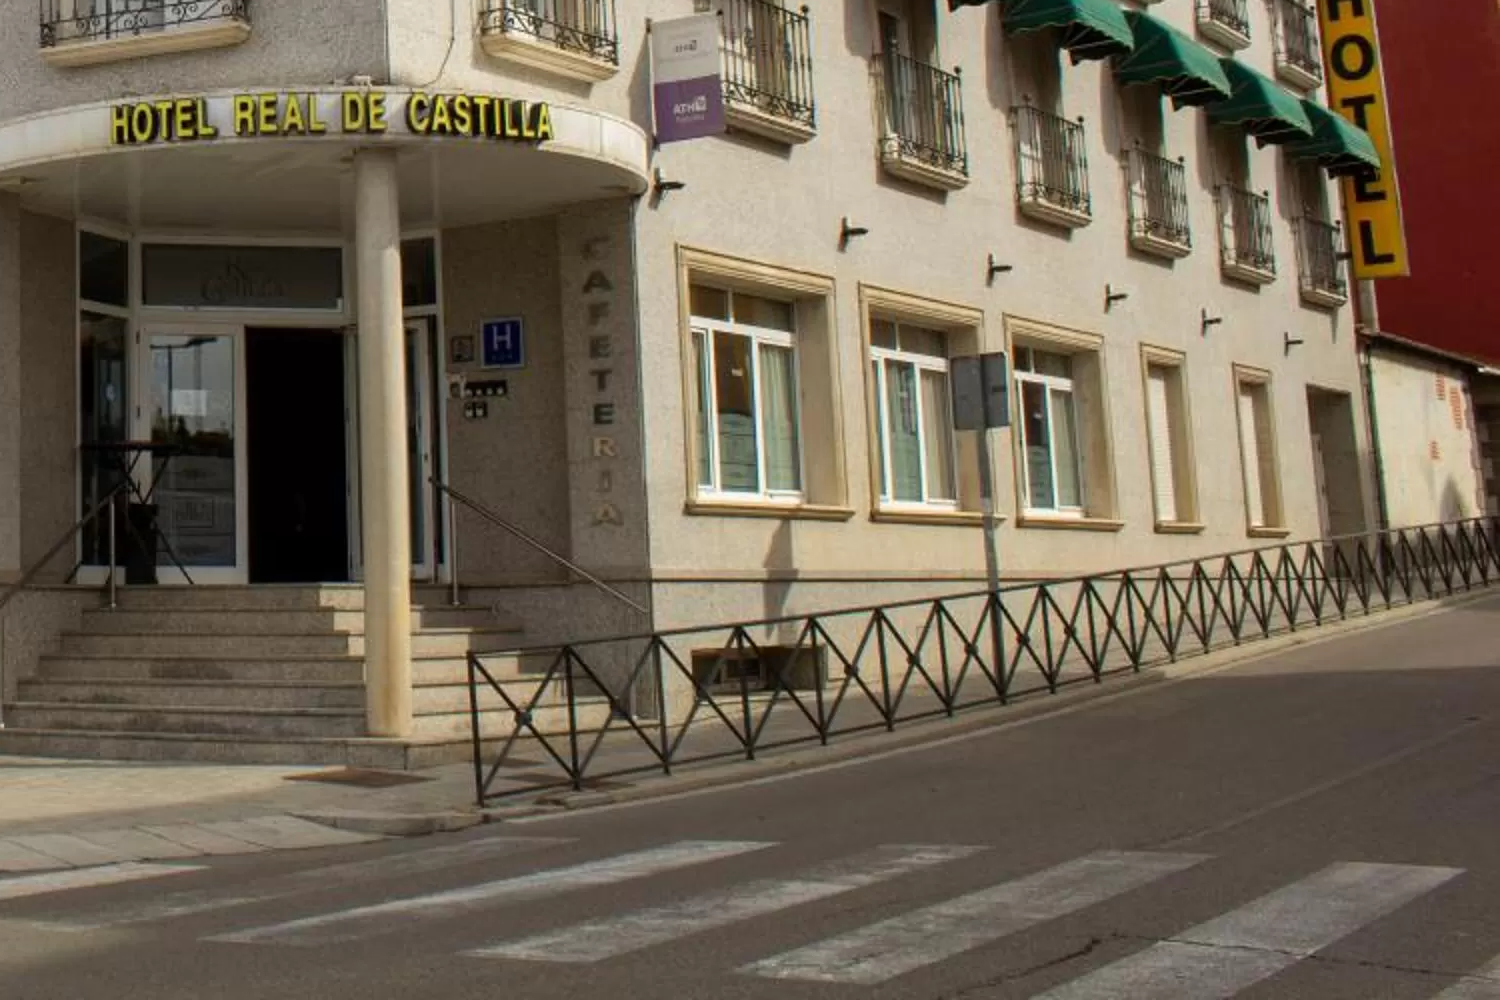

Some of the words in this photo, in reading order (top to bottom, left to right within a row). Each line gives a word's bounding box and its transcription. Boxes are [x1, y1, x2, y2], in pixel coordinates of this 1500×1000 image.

[110, 98, 217, 144] HOTEL
[233, 94, 329, 135] REAL
[341, 92, 387, 132] DE
[406, 93, 556, 140] CASTILLA
[492, 325, 513, 351] H
[580, 237, 625, 527] CAFETERIA
